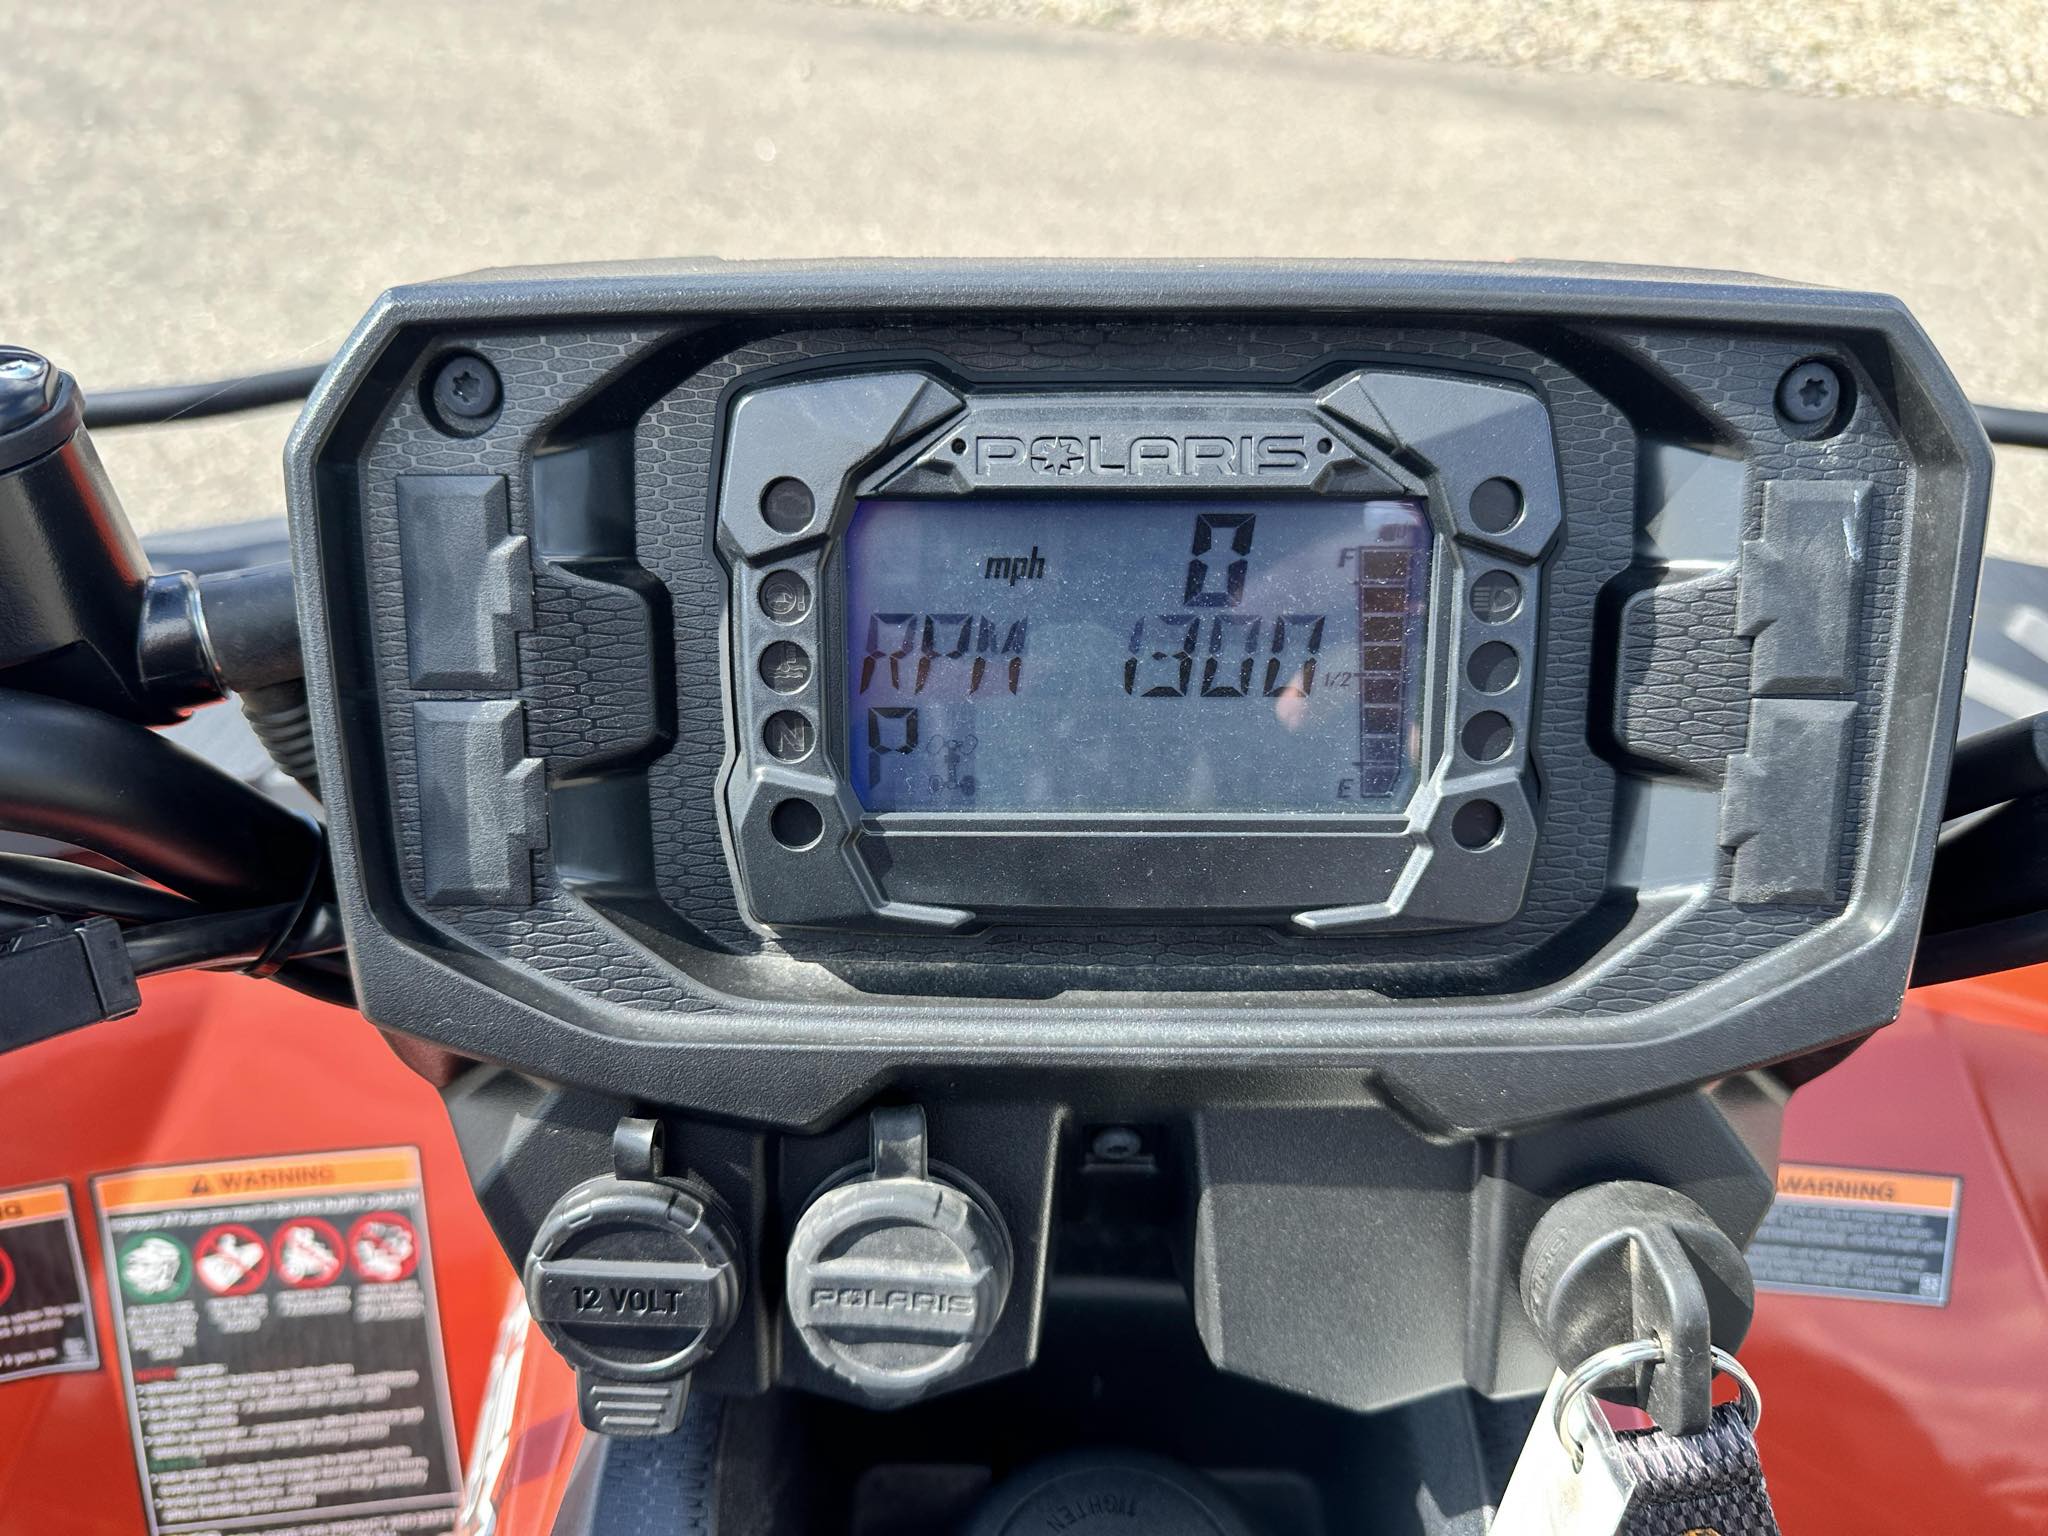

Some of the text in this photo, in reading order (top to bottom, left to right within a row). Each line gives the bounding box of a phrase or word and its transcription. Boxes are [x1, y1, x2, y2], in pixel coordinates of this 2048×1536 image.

[975, 434, 1310, 477] POLARIS
[985, 546, 1046, 587] mph
[1183, 512, 1257, 608] 0
[1337, 547, 1357, 568] F
[859, 612, 1029, 696] RPM
[1123, 613, 1326, 699] 1300
[1323, 672, 1352, 688] 1/2
[867, 706, 919, 791] P
[1336, 778, 1355, 799] E
[1781, 1175, 1896, 1201] WARNING
[571, 1286, 684, 1316] 12 VOLT
[810, 1287, 975, 1316] POLARIS
